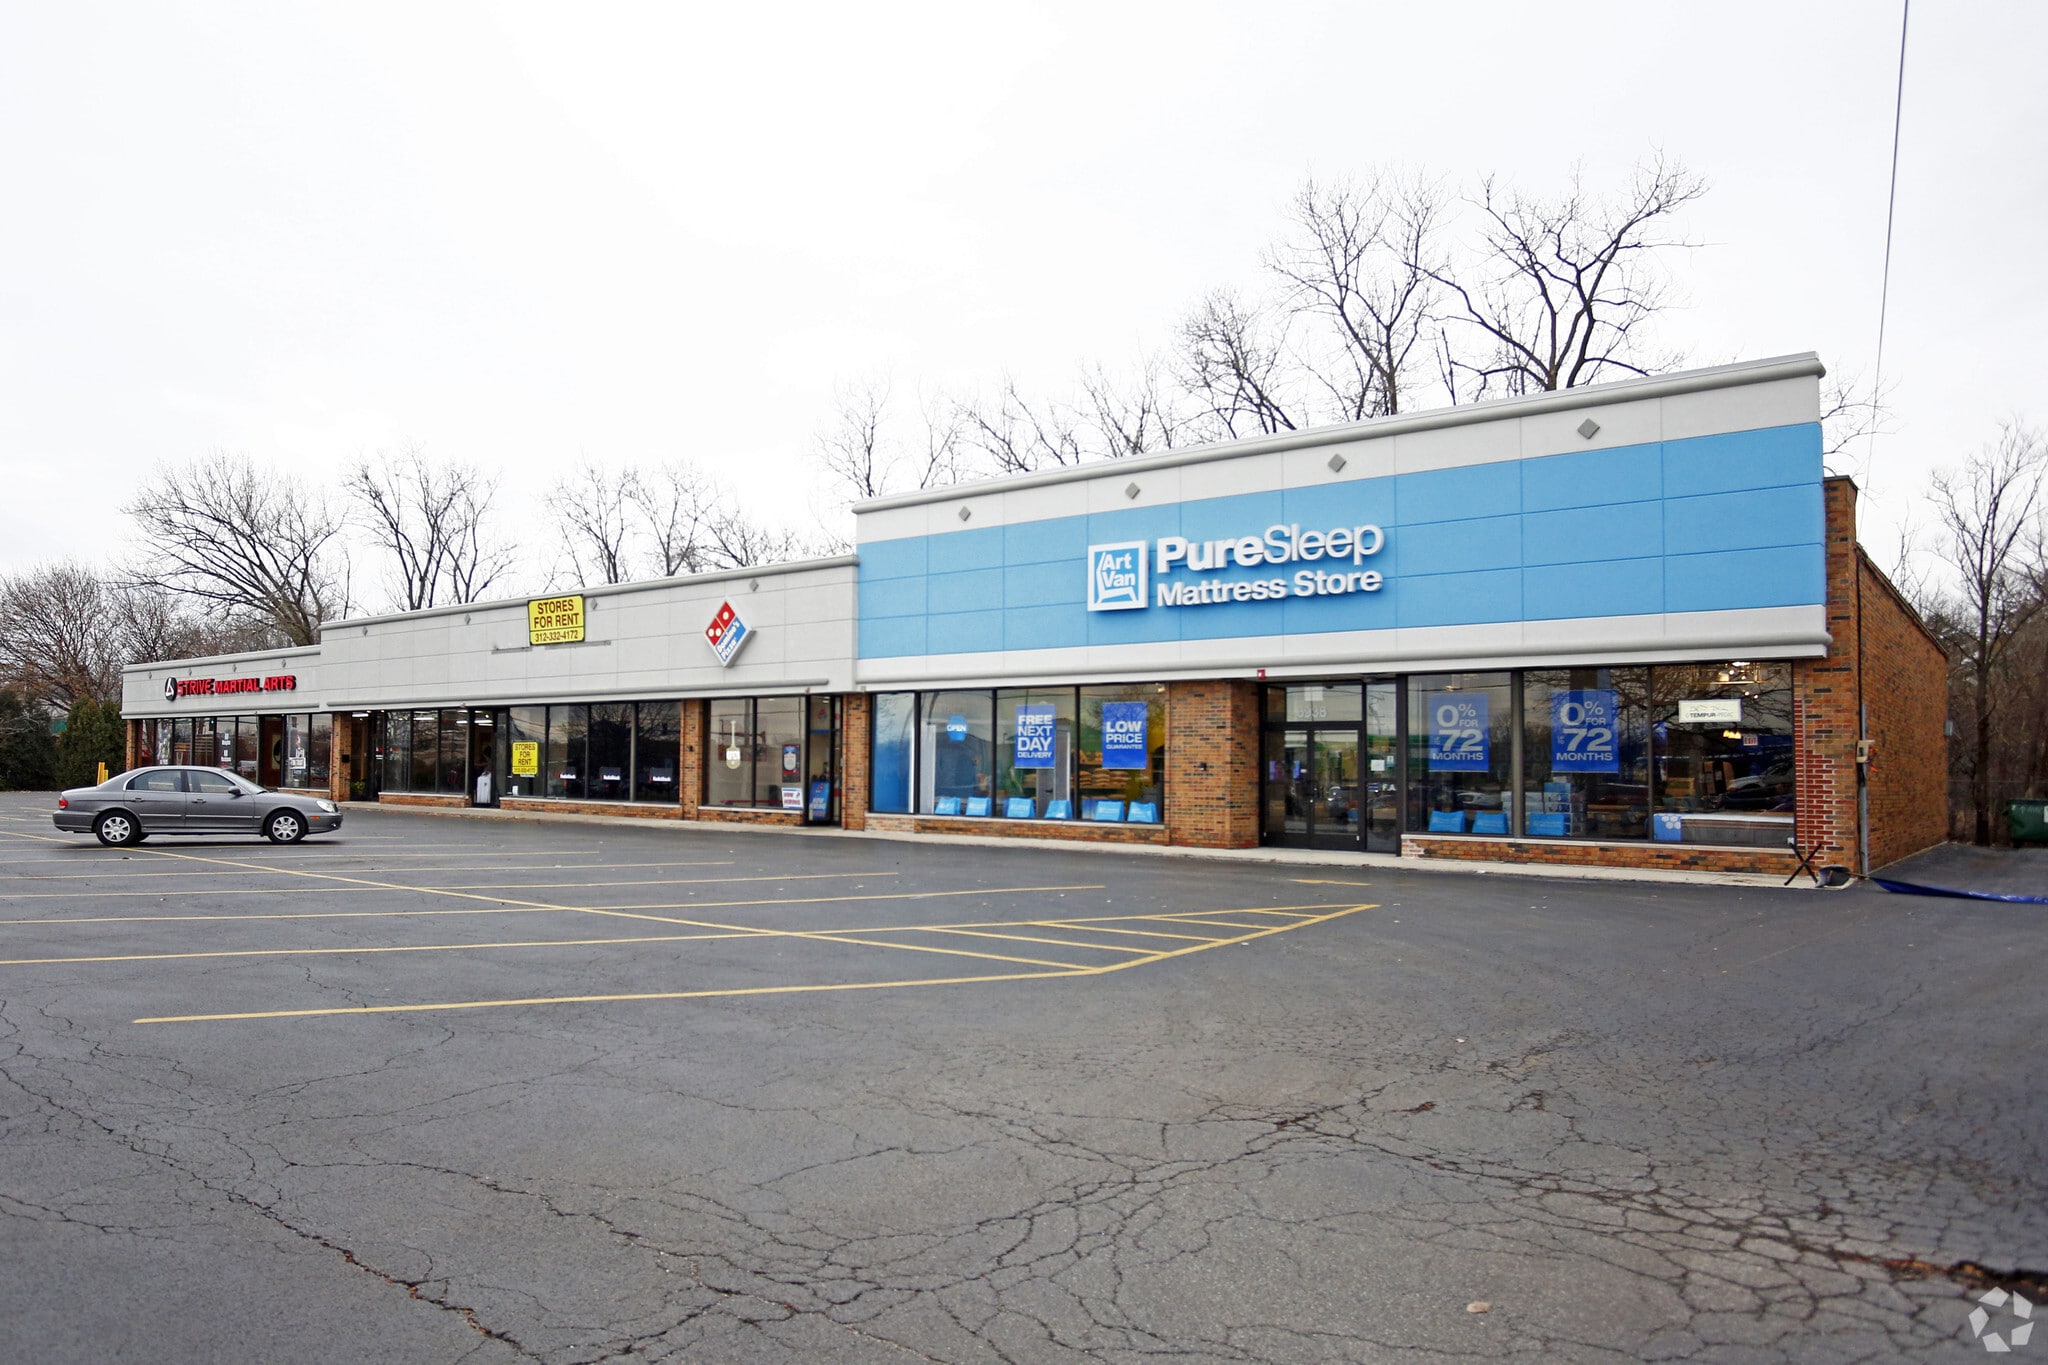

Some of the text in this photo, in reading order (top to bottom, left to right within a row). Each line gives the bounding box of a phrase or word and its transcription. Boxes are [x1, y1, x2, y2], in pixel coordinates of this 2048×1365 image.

[1157, 523, 1384, 573] PureSleep
[1101, 552, 1132, 571] Art
[1102, 572, 1136, 588] Van
[1157, 570, 1383, 607] Mattress Store
[537, 599, 574, 615] STORES
[534, 612, 580, 629] FOR RENT
[535, 630, 578, 643] 312-332-4172
[176, 675, 296, 697] STRIVE MARTIAL ARTS
[1018, 714, 1053, 725] FREE
[1459, 719, 1478, 727] FOR
[1585, 717, 1606, 726] FOR
[946, 724, 967, 732] OPEN
[1017, 725, 1053, 737] NEXT
[1106, 721, 1143, 732] LOW
[1017, 737, 1052, 751] DAY
[1106, 733, 1143, 743] PRICE
[1439, 728, 1484, 752] 72
[1562, 727, 1613, 752] 72
[514, 743, 536, 751] STORES
[1017, 751, 1053, 759] DELIVERY
[1432, 752, 1485, 761] MONTHS
[1556, 752, 1614, 761] MONTHS
[518, 758, 532, 766] RENT
